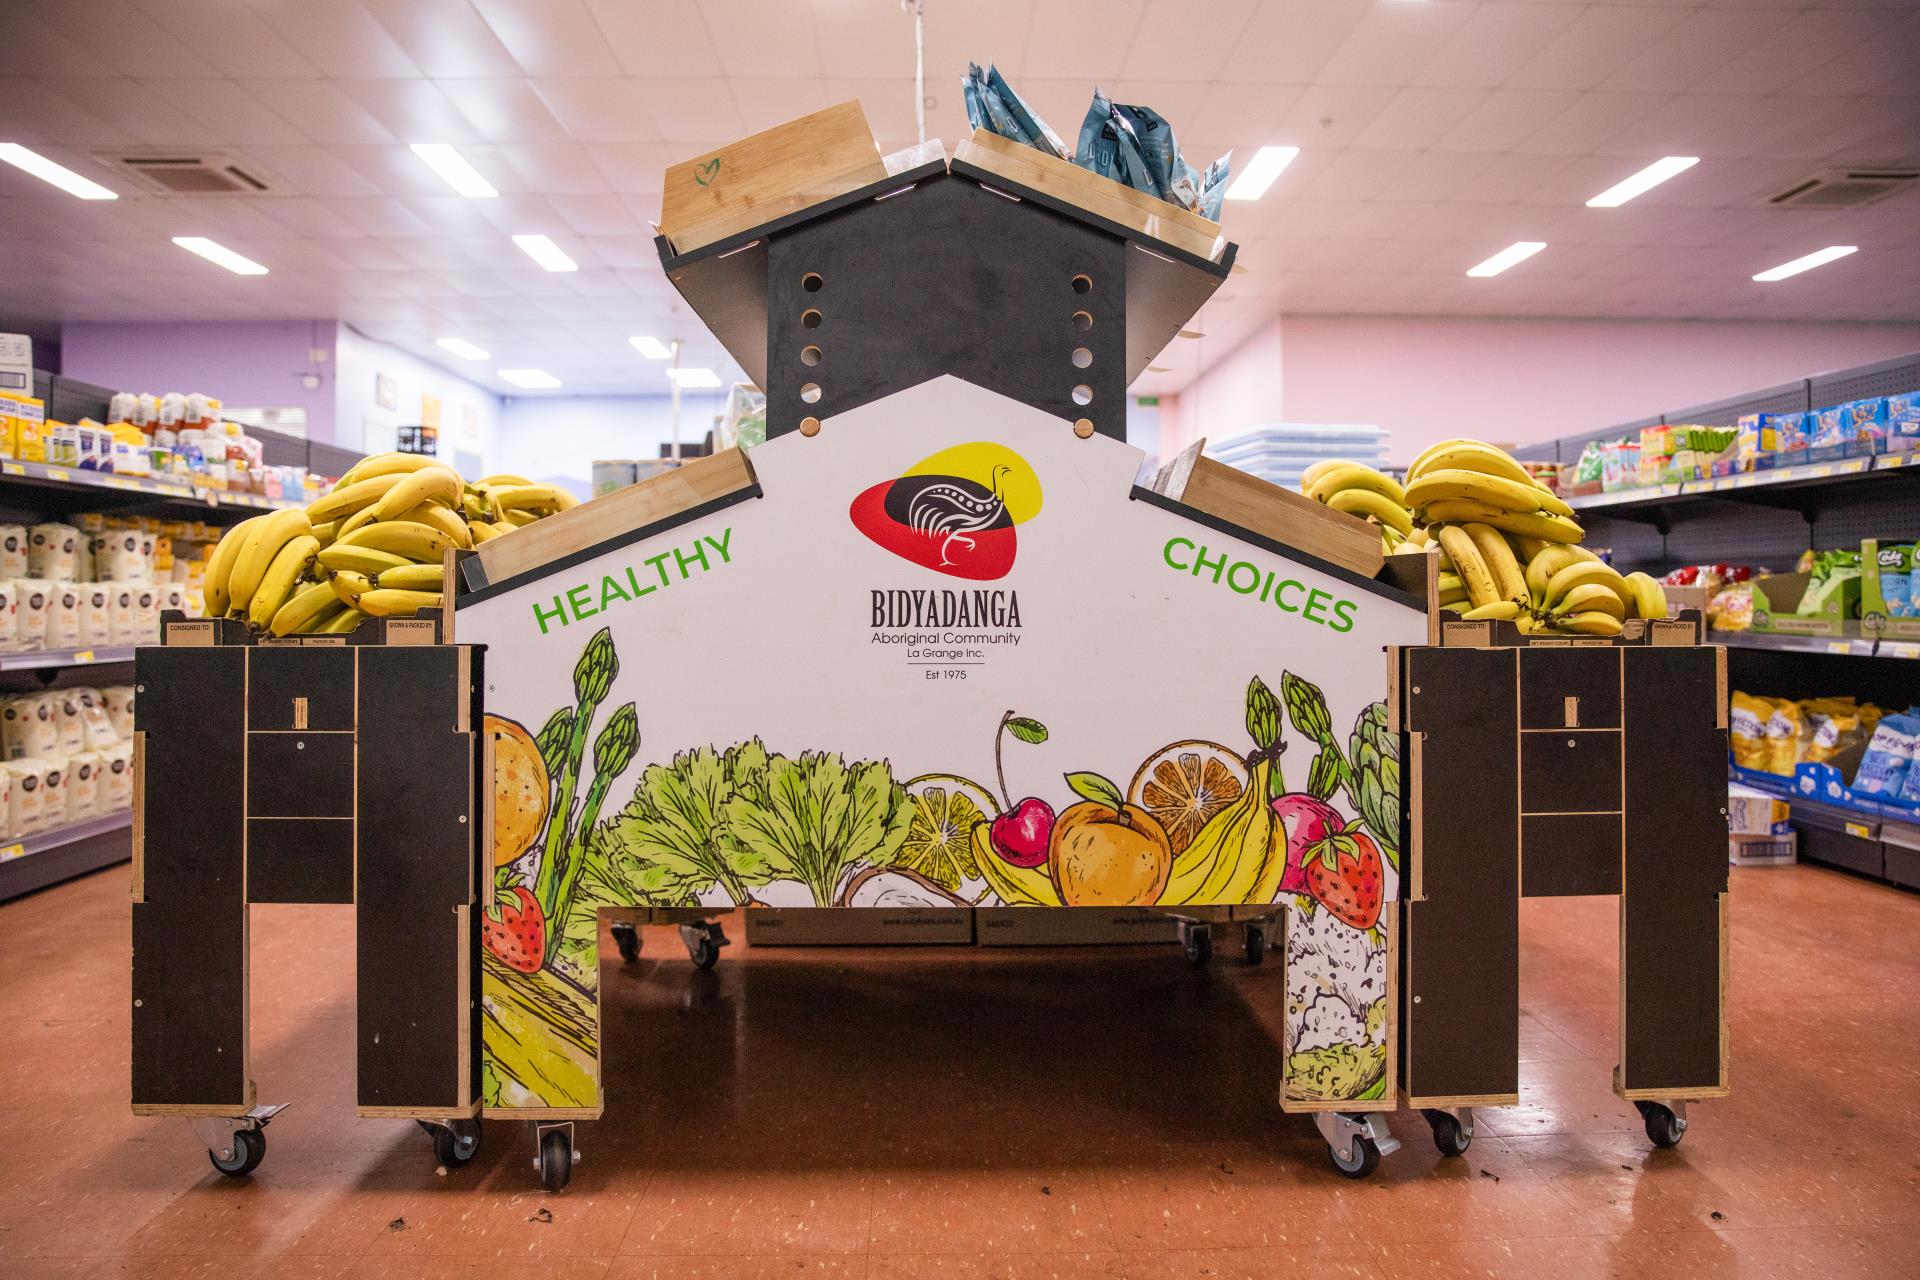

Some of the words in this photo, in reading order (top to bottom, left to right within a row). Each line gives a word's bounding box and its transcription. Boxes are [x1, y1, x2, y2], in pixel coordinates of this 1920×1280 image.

[532, 527, 731, 634] HEALTHY
[1163, 537, 1358, 632] CHOICES
[870, 590, 1022, 627] BIDYADANGA
[871, 632, 940, 646] Aboriginal
[943, 632, 1021, 646] Community
[907, 648, 920, 658] La
[922, 648, 963, 660] Grange
[966, 648, 985, 658] Inc.
[926, 670, 940, 680] Est
[943, 670, 967, 680] 1975
